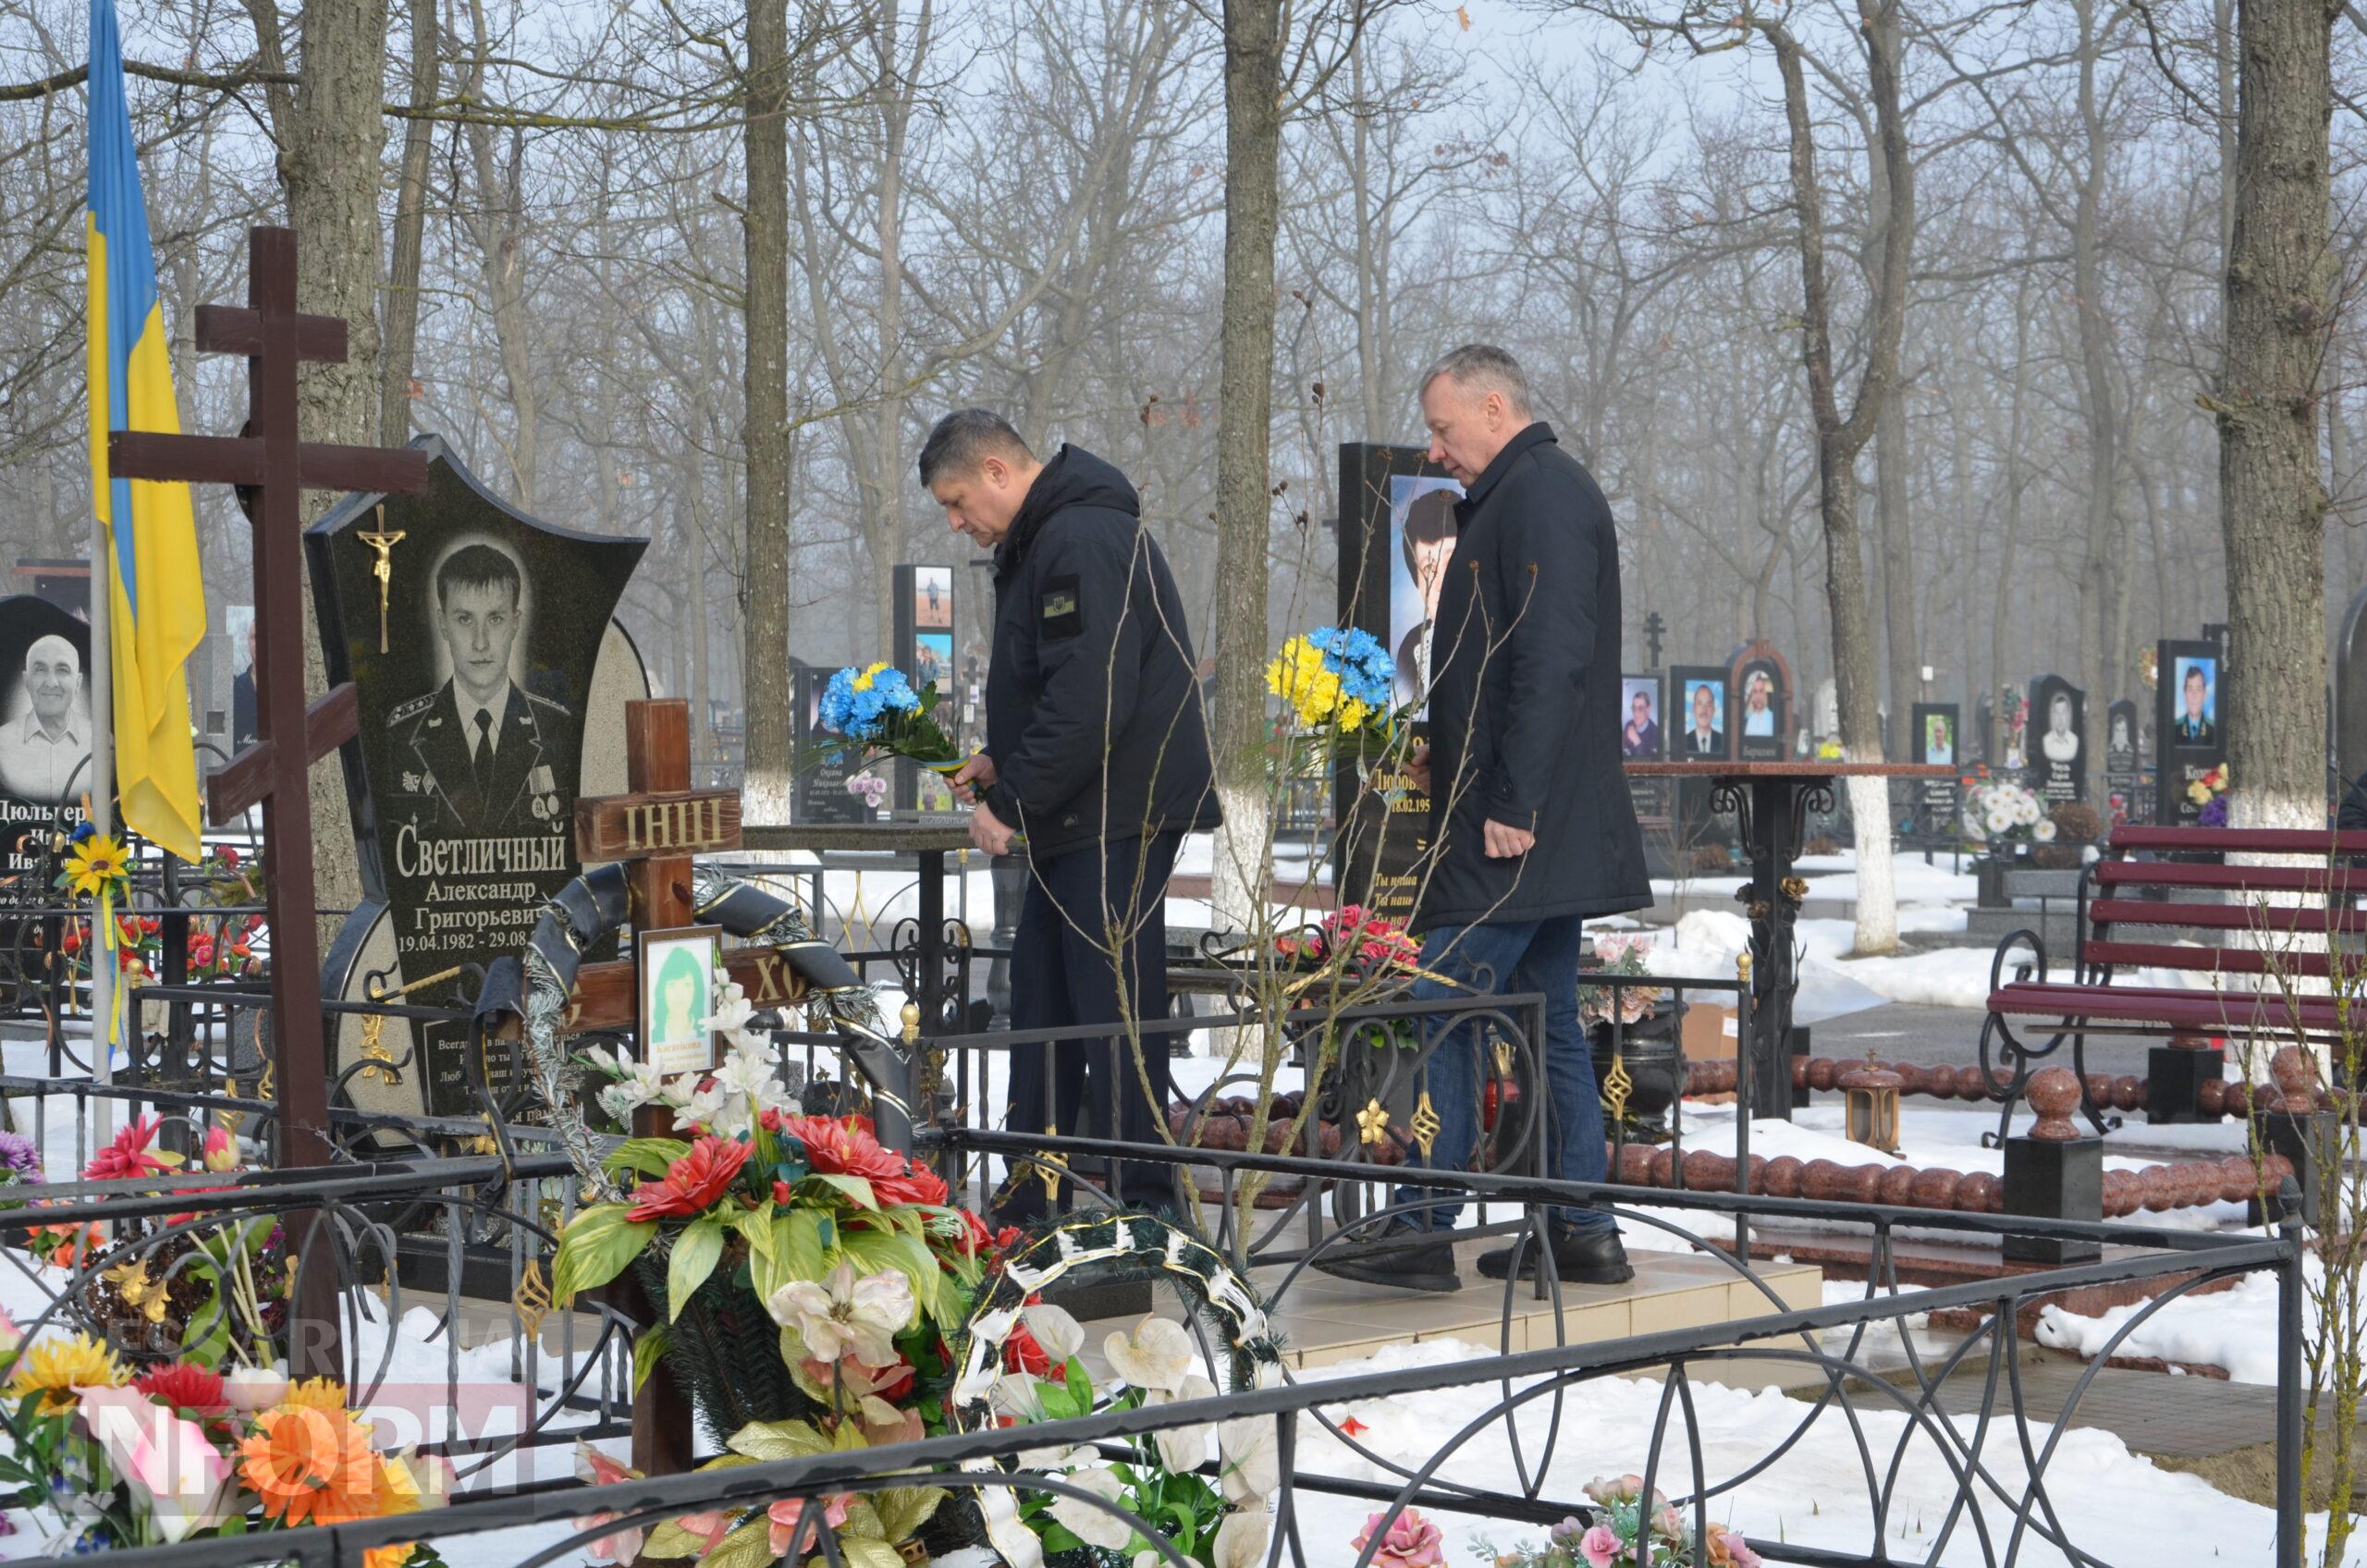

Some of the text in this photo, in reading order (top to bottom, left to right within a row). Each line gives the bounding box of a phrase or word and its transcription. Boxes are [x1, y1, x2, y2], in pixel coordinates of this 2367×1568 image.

[1392, 799, 1430, 813] 18.02.195
[396, 821, 566, 877] Светличный
[1375, 873, 1417, 887] Ты наша
[424, 879, 536, 904] Александр
[399, 933, 475, 952] 19.04.1982
[489, 931, 526, 948] 29.08
[437, 1038, 469, 1051] Всегд
